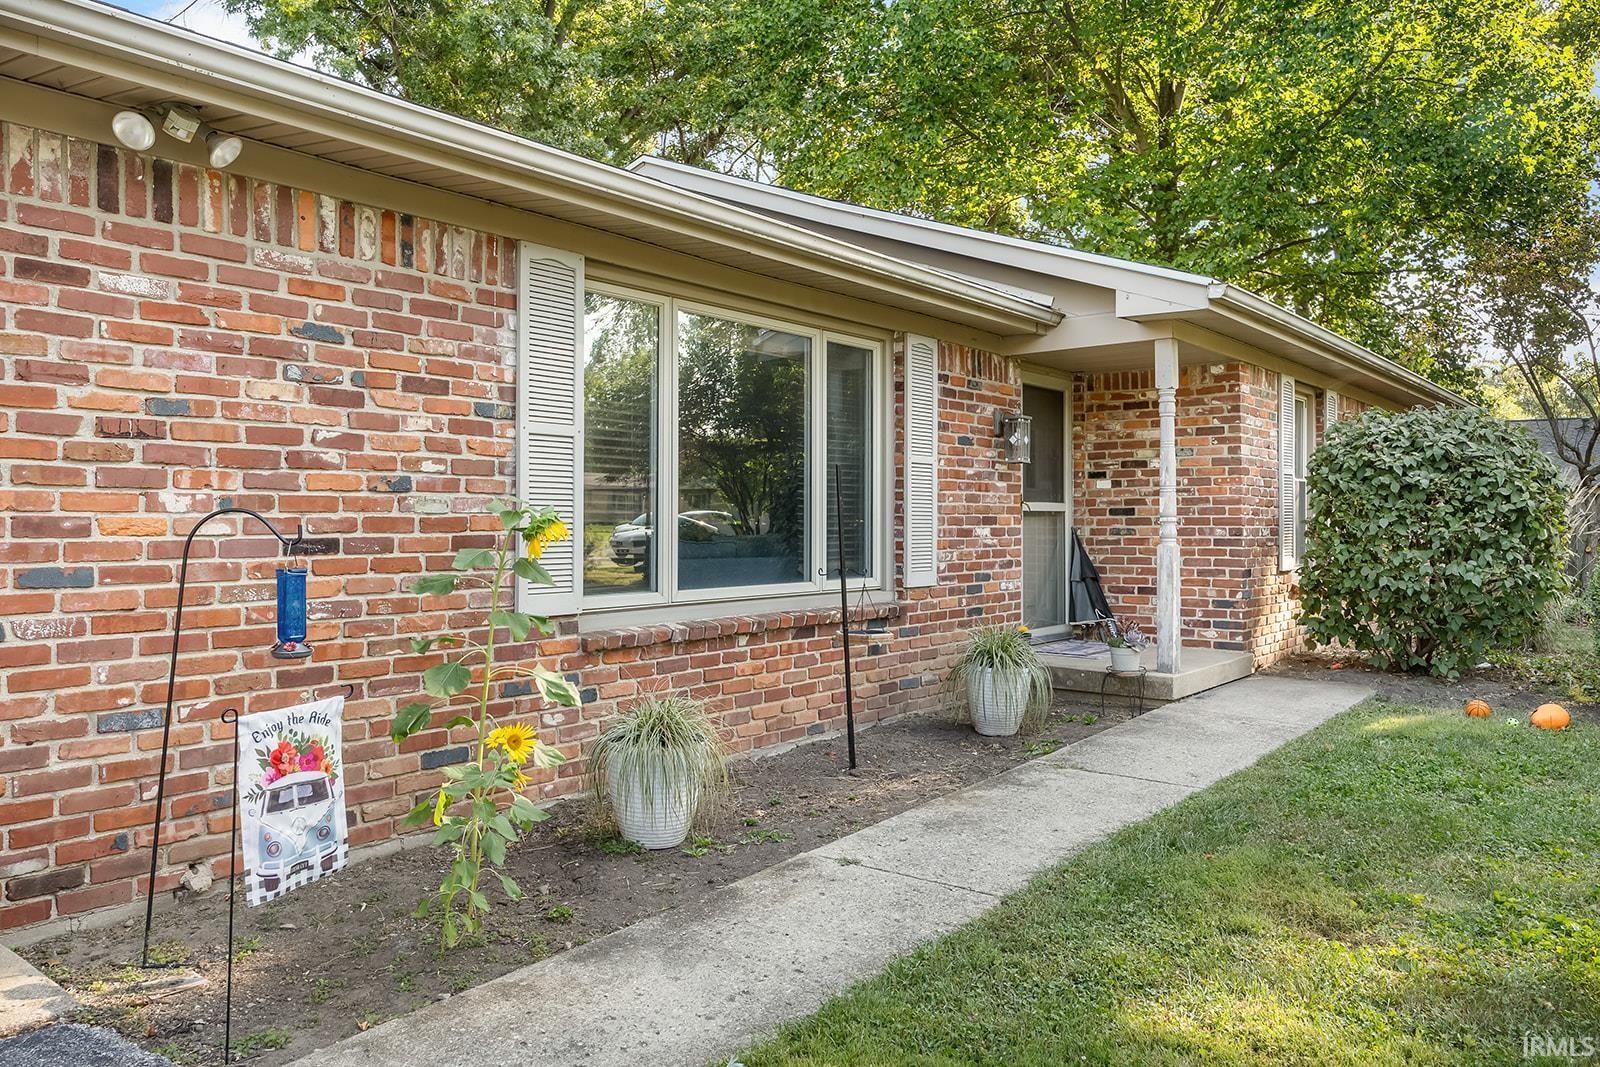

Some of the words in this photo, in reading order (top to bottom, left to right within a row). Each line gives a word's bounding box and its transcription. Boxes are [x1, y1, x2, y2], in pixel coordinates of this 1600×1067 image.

[251, 720, 284, 744] Enjoy
[287, 712, 305, 727] the
[308, 710, 331, 727] Ride
